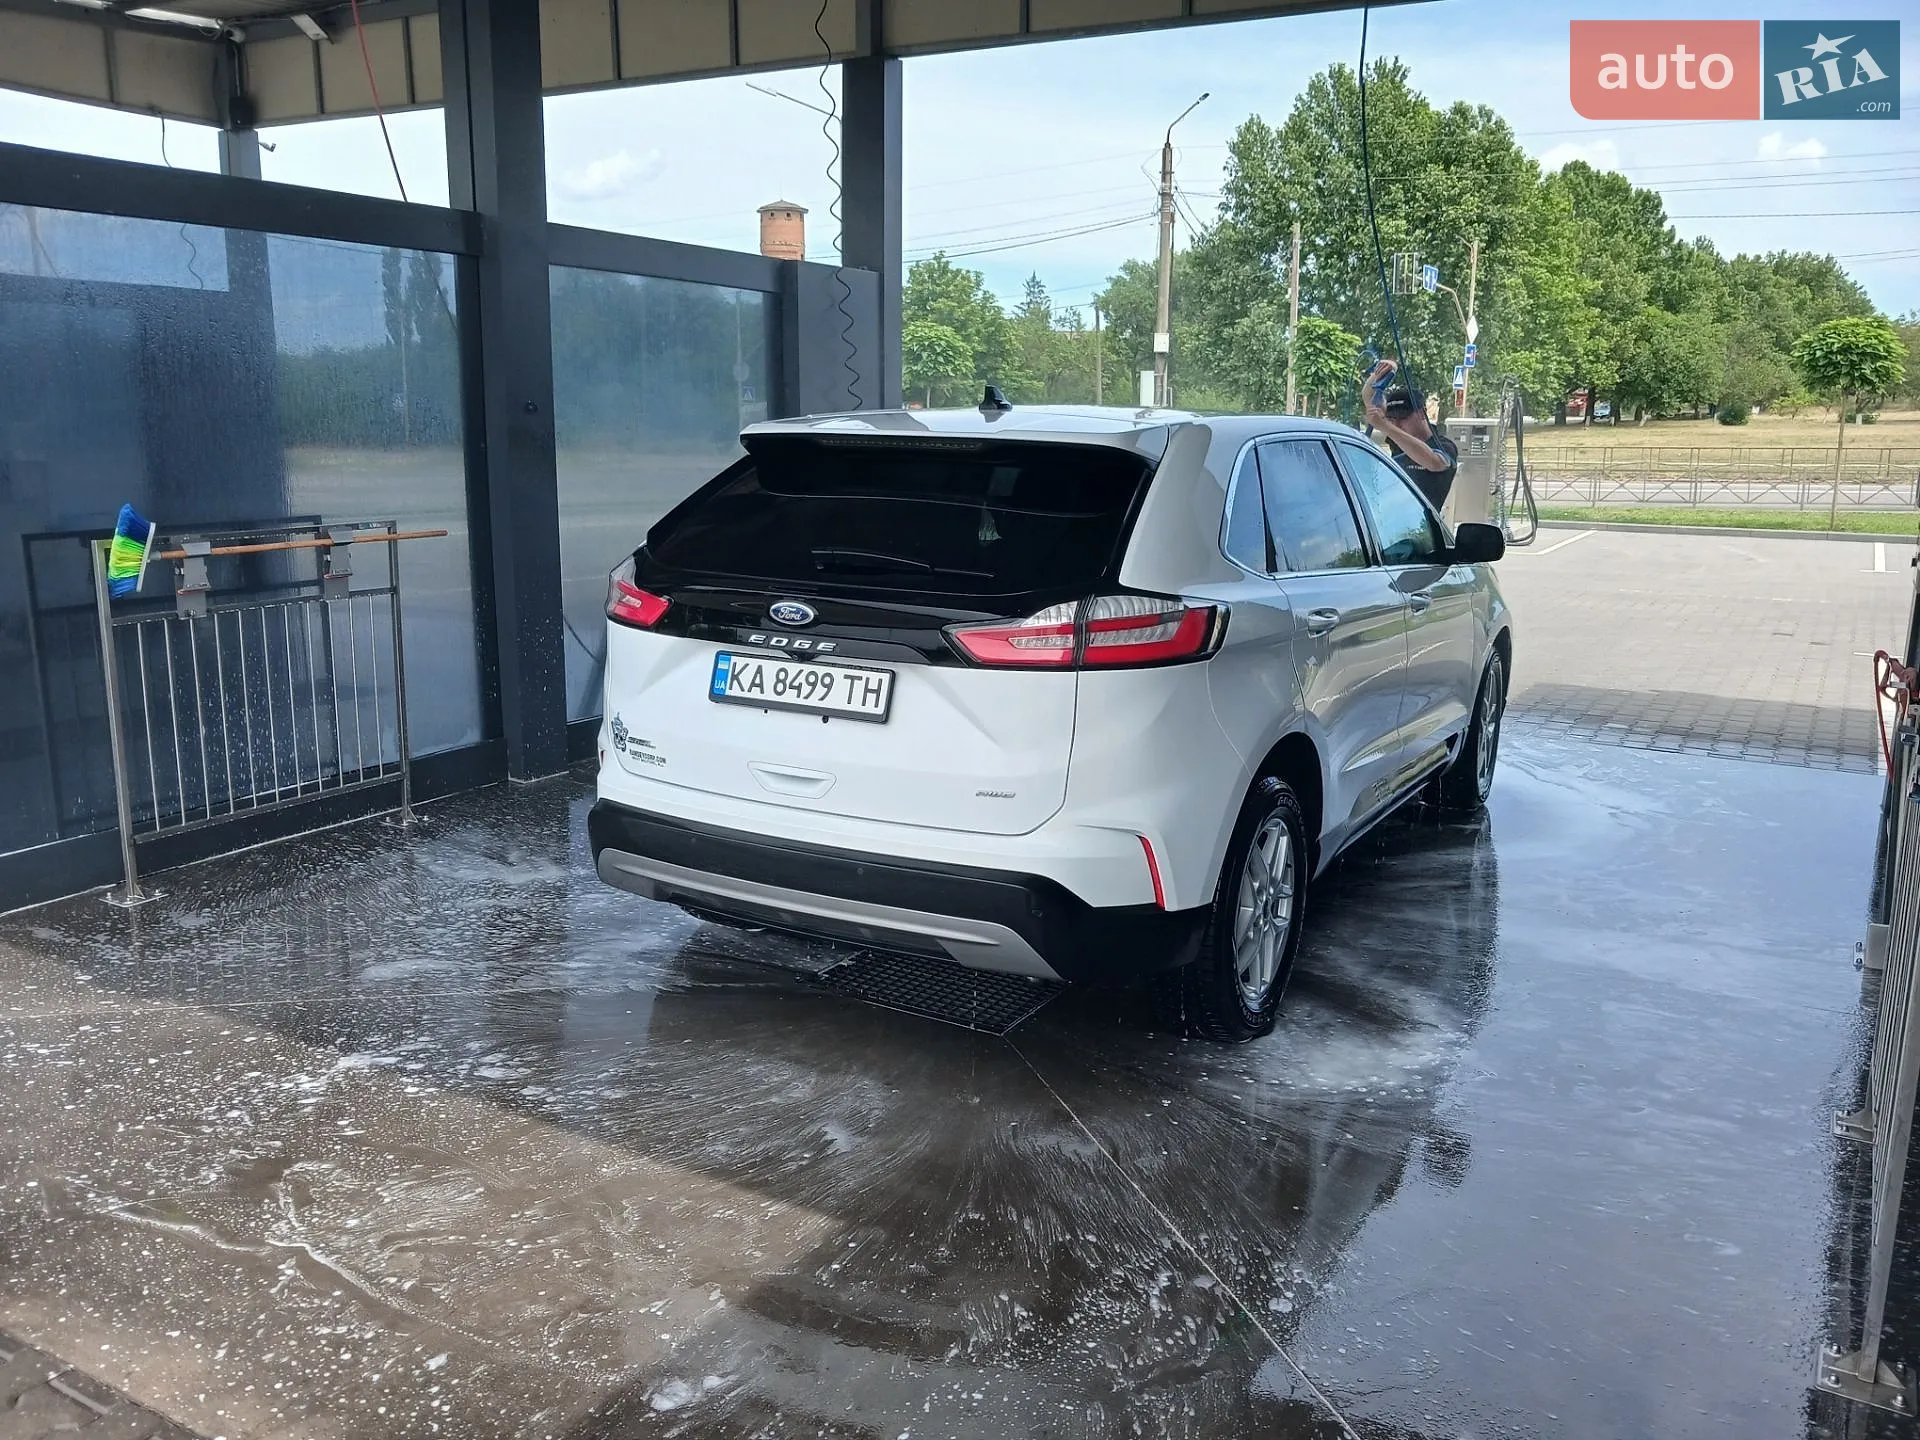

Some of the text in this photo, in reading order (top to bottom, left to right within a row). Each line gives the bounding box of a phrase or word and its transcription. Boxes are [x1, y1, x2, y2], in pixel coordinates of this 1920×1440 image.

[778, 606, 803, 621] Ford
[748, 634, 837, 651] EDGE
[714, 679, 726, 690] UA
[728, 661, 883, 708] KA 8499 TH
